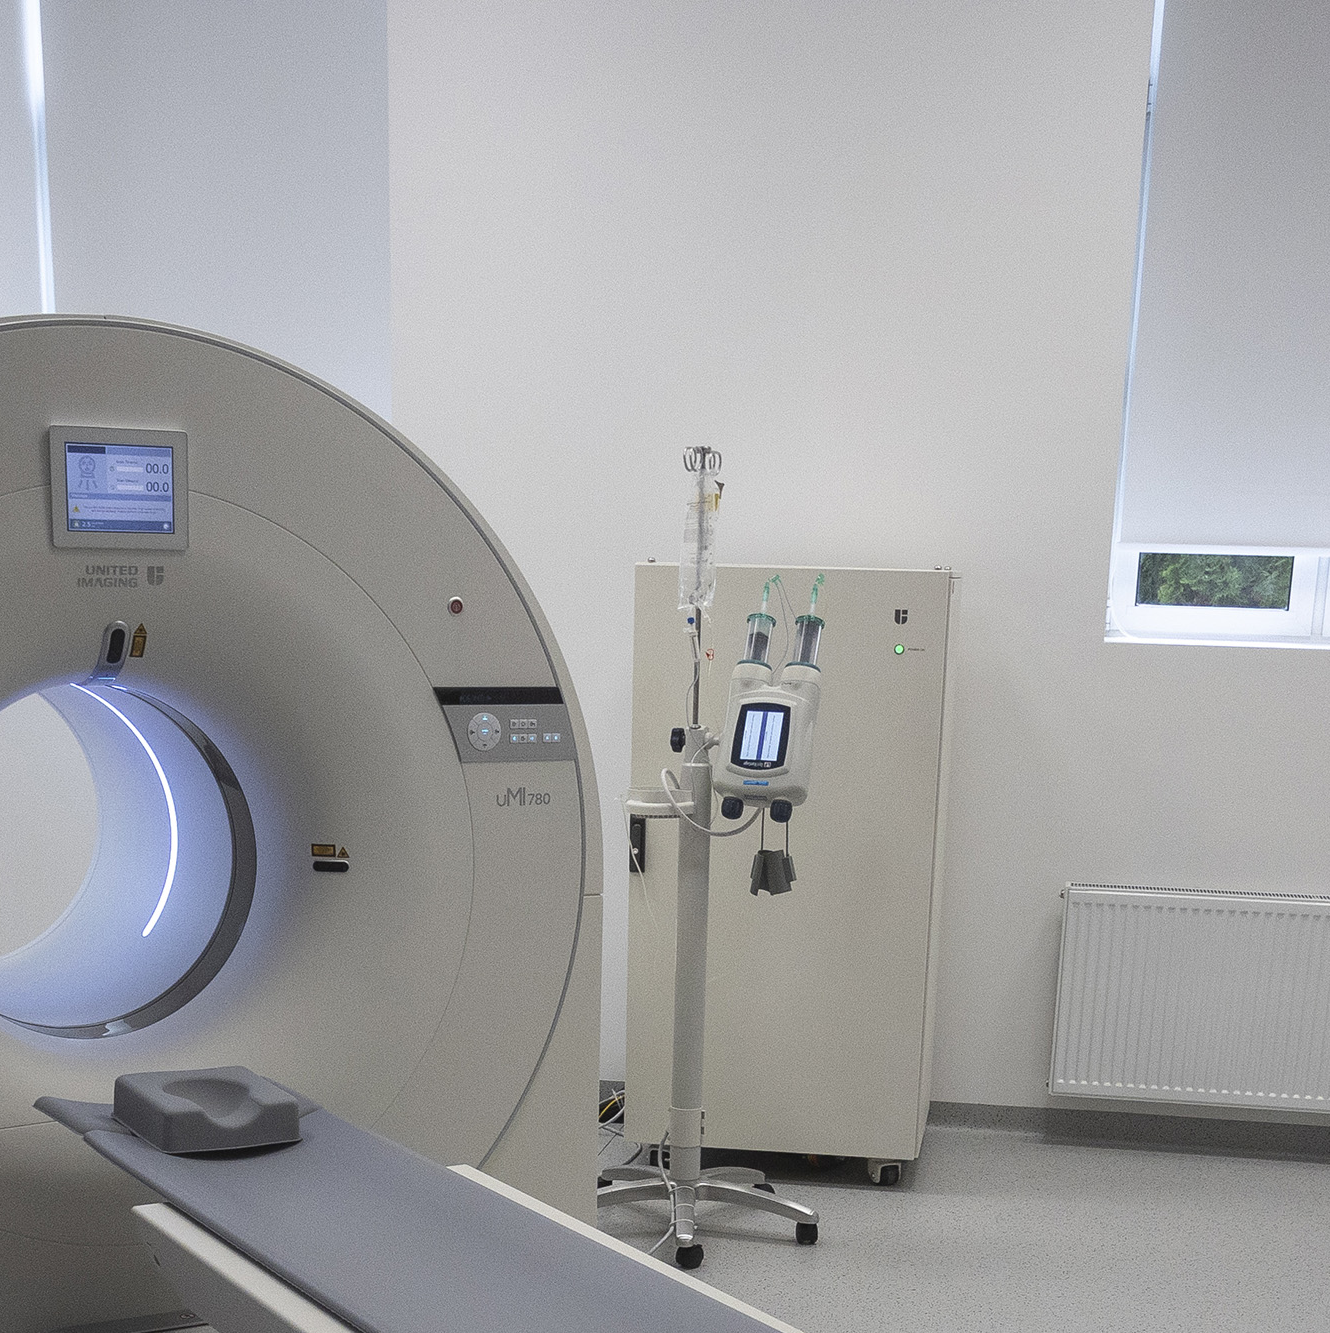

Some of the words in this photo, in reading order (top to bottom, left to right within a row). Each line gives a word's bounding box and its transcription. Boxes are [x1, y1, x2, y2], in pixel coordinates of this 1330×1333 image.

[145, 463, 169, 474] 00.0
[145, 481, 170, 493] 00.0
[85, 565, 139, 576] UNITED
[77, 577, 138, 588] IMAGING
